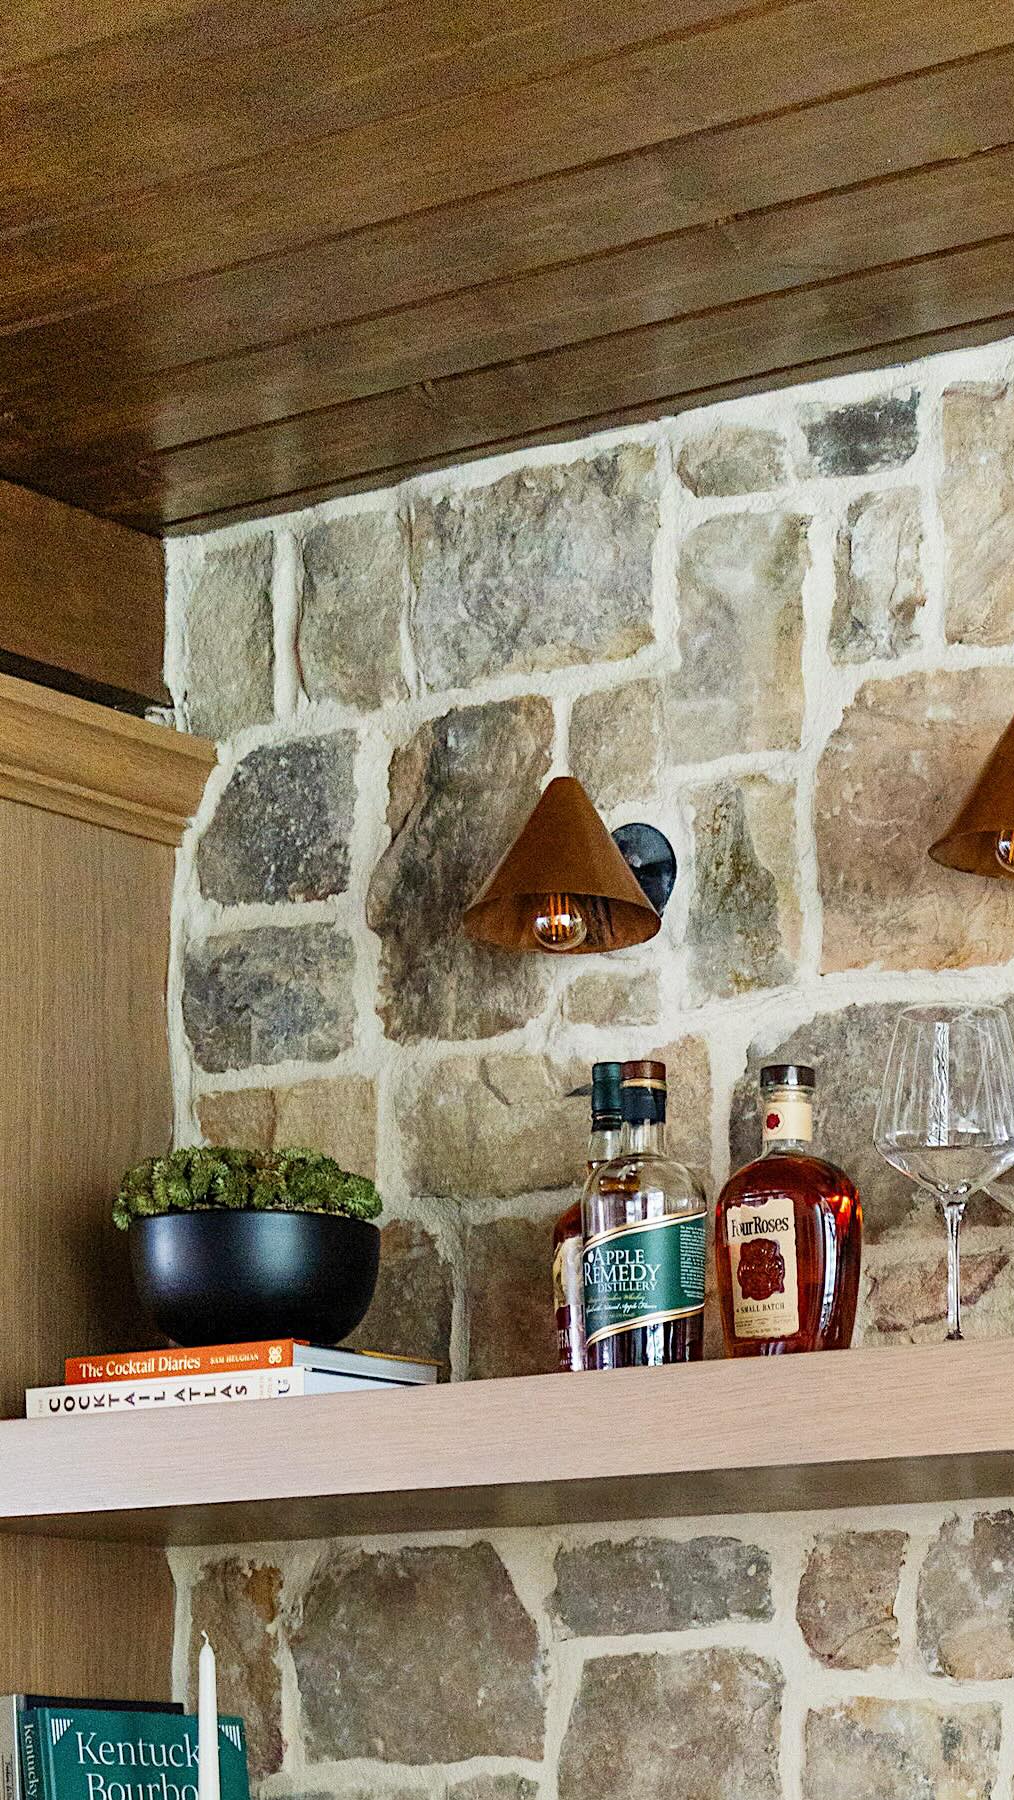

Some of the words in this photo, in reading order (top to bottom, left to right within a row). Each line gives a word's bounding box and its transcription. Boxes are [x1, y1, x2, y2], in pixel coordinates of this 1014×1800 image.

[732, 1218, 754, 1237] Four
[753, 1216, 789, 1234] Roses
[592, 1246, 645, 1266] APPLE
[584, 1262, 661, 1286] REMEDY
[598, 1281, 658, 1293] DISTILLERY
[740, 1304, 760, 1313] SMALL
[762, 1302, 785, 1312] BATCH
[79, 1362, 103, 1378] The
[106, 1356, 155, 1377] Cocktail
[158, 1354, 201, 1371] Diaries
[209, 1356, 225, 1365] SAM
[49, 1391, 166, 1412] COCKTAIL
[174, 1385, 248, 1402] ATLAS
[24, 1724, 40, 1798] Kentucky
[76, 1731, 220, 1768] Kentuck
